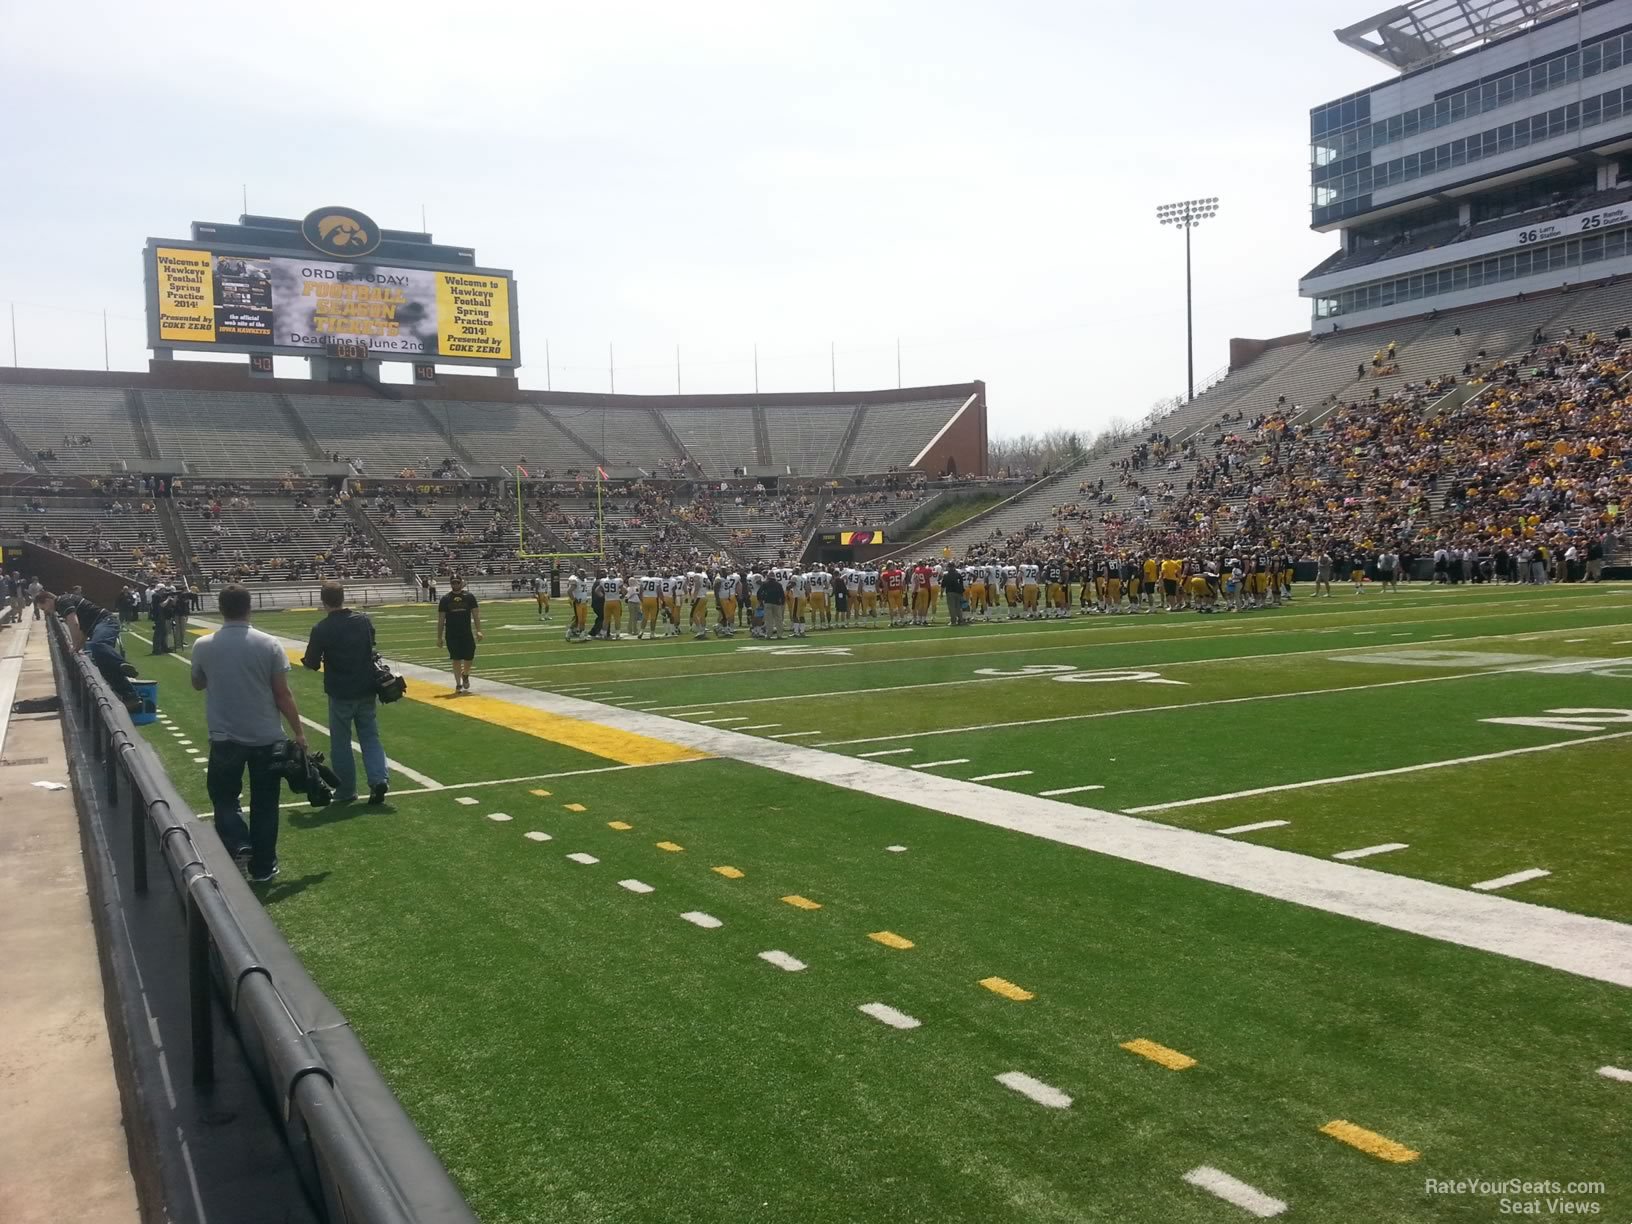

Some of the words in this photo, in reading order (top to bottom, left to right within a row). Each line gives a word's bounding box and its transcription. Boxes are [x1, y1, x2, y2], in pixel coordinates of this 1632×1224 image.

[1581, 215, 1600, 230] 25
[1603, 215, 1628, 225] Duncan
[1519, 230, 1537, 244] 36
[1540, 230, 1561, 239] Station
[158, 256, 199, 266] Welcome
[164, 266, 205, 276] Hawkeye
[167, 274, 202, 283] Football
[302, 268, 353, 282] ORDER
[356, 272, 409, 286] TODAY!
[444, 276, 487, 287] Welcome
[170, 283, 200, 293] Spring
[302, 281, 406, 304] FOOTBALL
[450, 286, 494, 298] Hawkeye
[167, 291, 204, 300] Practice
[174, 300, 198, 308] 2014!
[454, 296, 491, 307] Football
[316, 299, 396, 320] SEASON
[457, 306, 489, 318] Spring
[160, 314, 200, 322] Presented
[454, 316, 494, 326] Practice
[162, 321, 186, 330] COKE
[188, 322, 212, 331] ZERO
[237, 327, 272, 335] HAWKEYES
[314, 317, 400, 336] TICKETS
[462, 326, 487, 335] 2014!
[290, 333, 352, 345] Deadline
[356, 336, 366, 346] is
[368, 338, 398, 350] June
[402, 340, 424, 351] 2nd
[447, 334, 489, 344] Presented
[450, 344, 474, 352] COKE
[476, 346, 501, 354] ZERO
[253, 358, 271, 370] 40
[416, 367, 433, 379] 40
[1109, 561, 1118, 570] 87
[776, 571, 788, 581] 94
[1026, 569, 1036, 578] 72
[1050, 569, 1060, 578] 29
[810, 577, 822, 586] 54
[848, 574, 859, 584] 43
[864, 576, 876, 586] 48
[889, 576, 900, 586] 25
[604, 582, 616, 592] 99
[643, 581, 655, 591] 78
